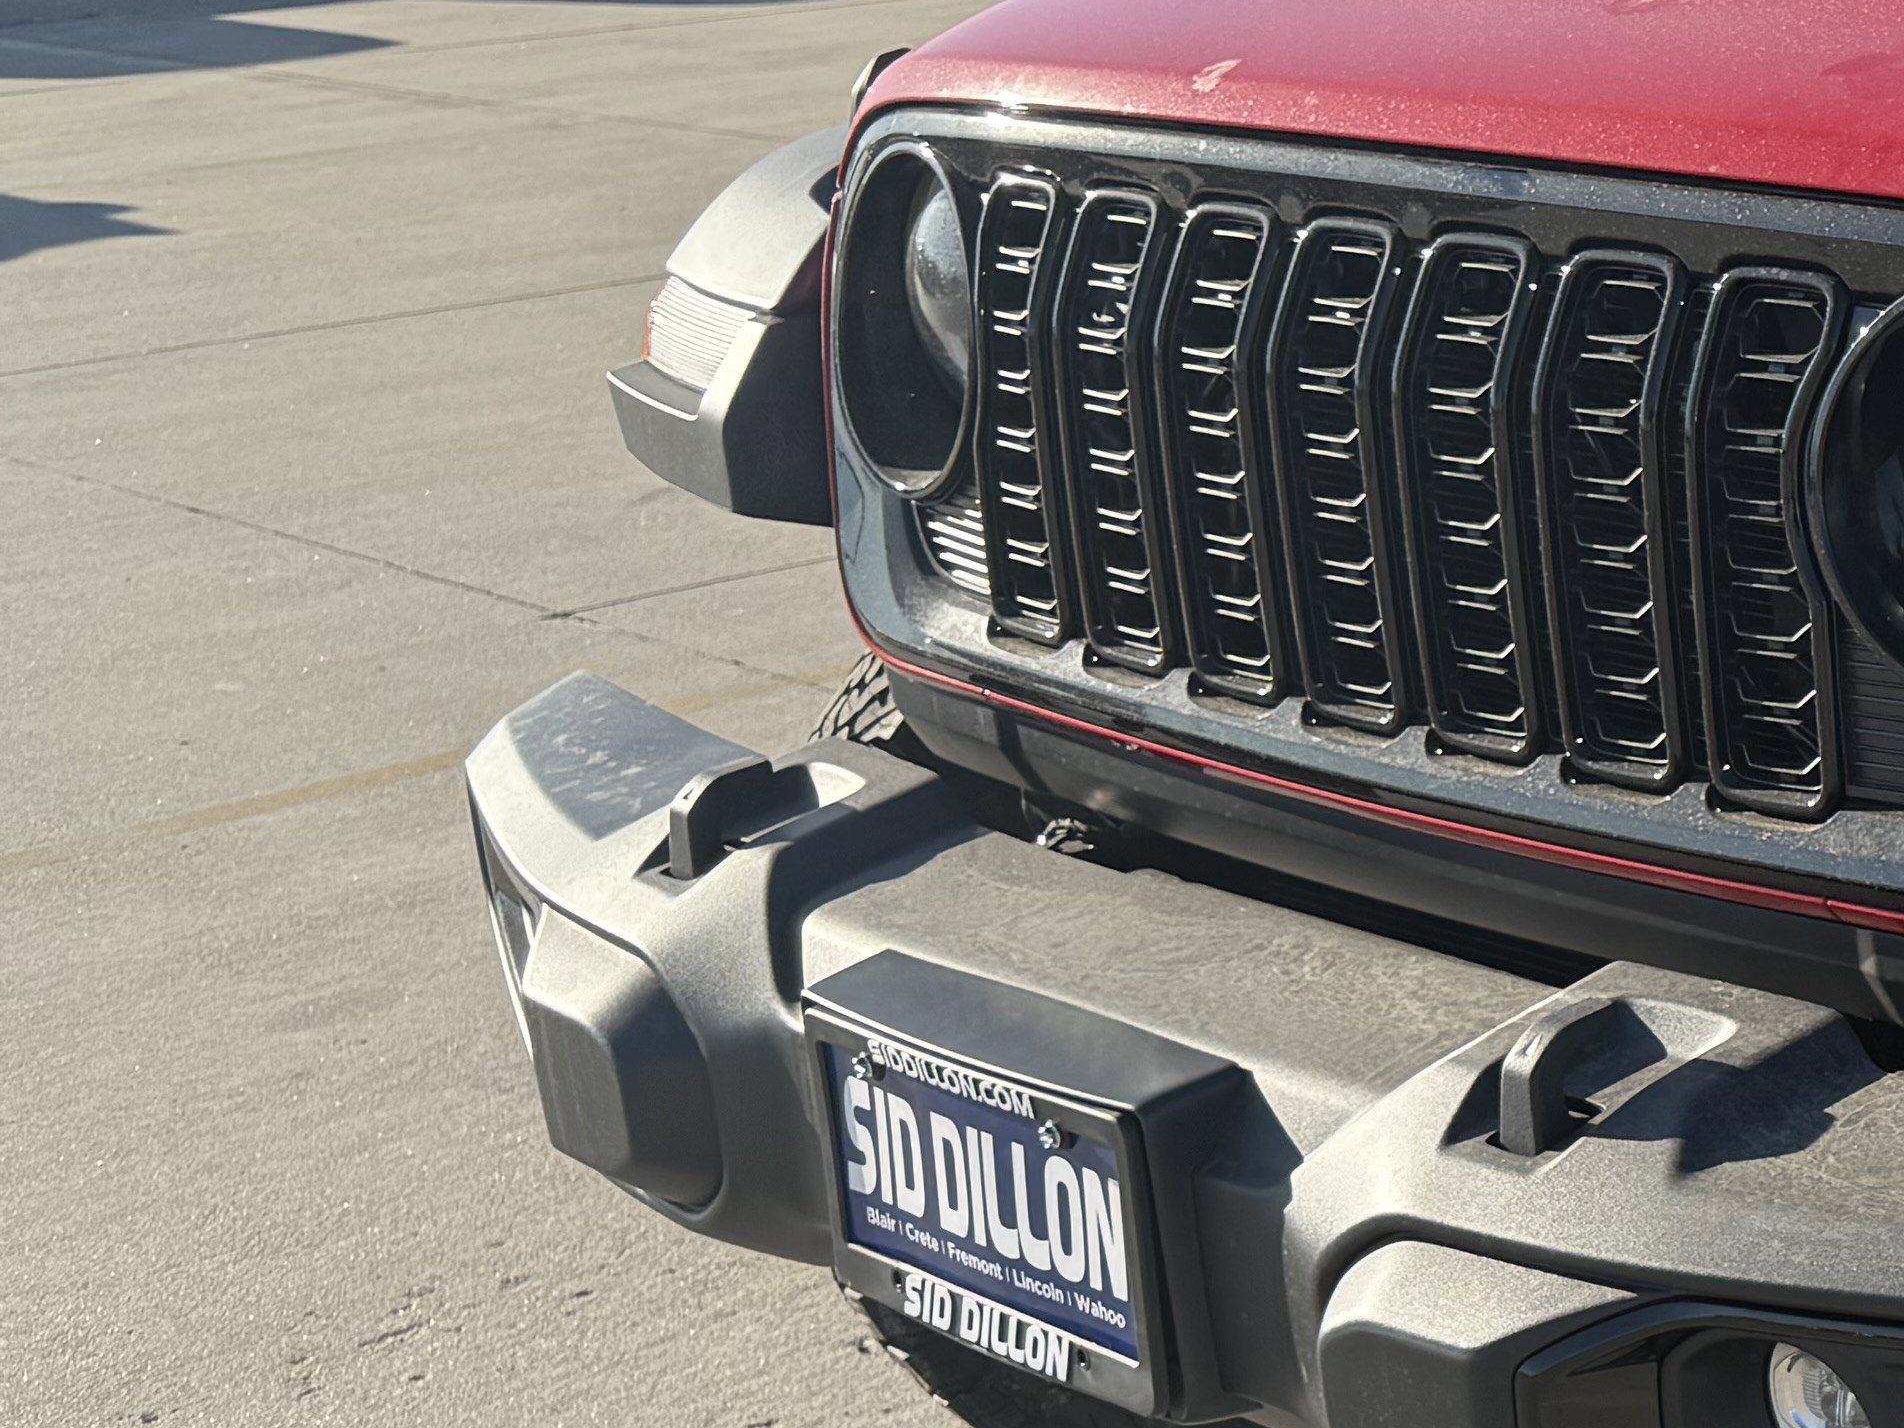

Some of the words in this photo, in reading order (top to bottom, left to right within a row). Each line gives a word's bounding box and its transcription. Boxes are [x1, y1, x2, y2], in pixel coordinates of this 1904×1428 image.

[867, 1039, 1035, 1119] SIDDILLON.COM
[843, 1075, 926, 1219] SID
[929, 1110, 1129, 1303] DILLON
[866, 1206, 897, 1234] Blair
[904, 1221, 940, 1253] Crete
[946, 1240, 1004, 1280] Fremont
[1012, 1268, 1065, 1305] Lincoln
[1073, 1290, 1127, 1330] Wahoo
[903, 1274, 952, 1334] SID
[959, 1299, 1070, 1382] DILLON
